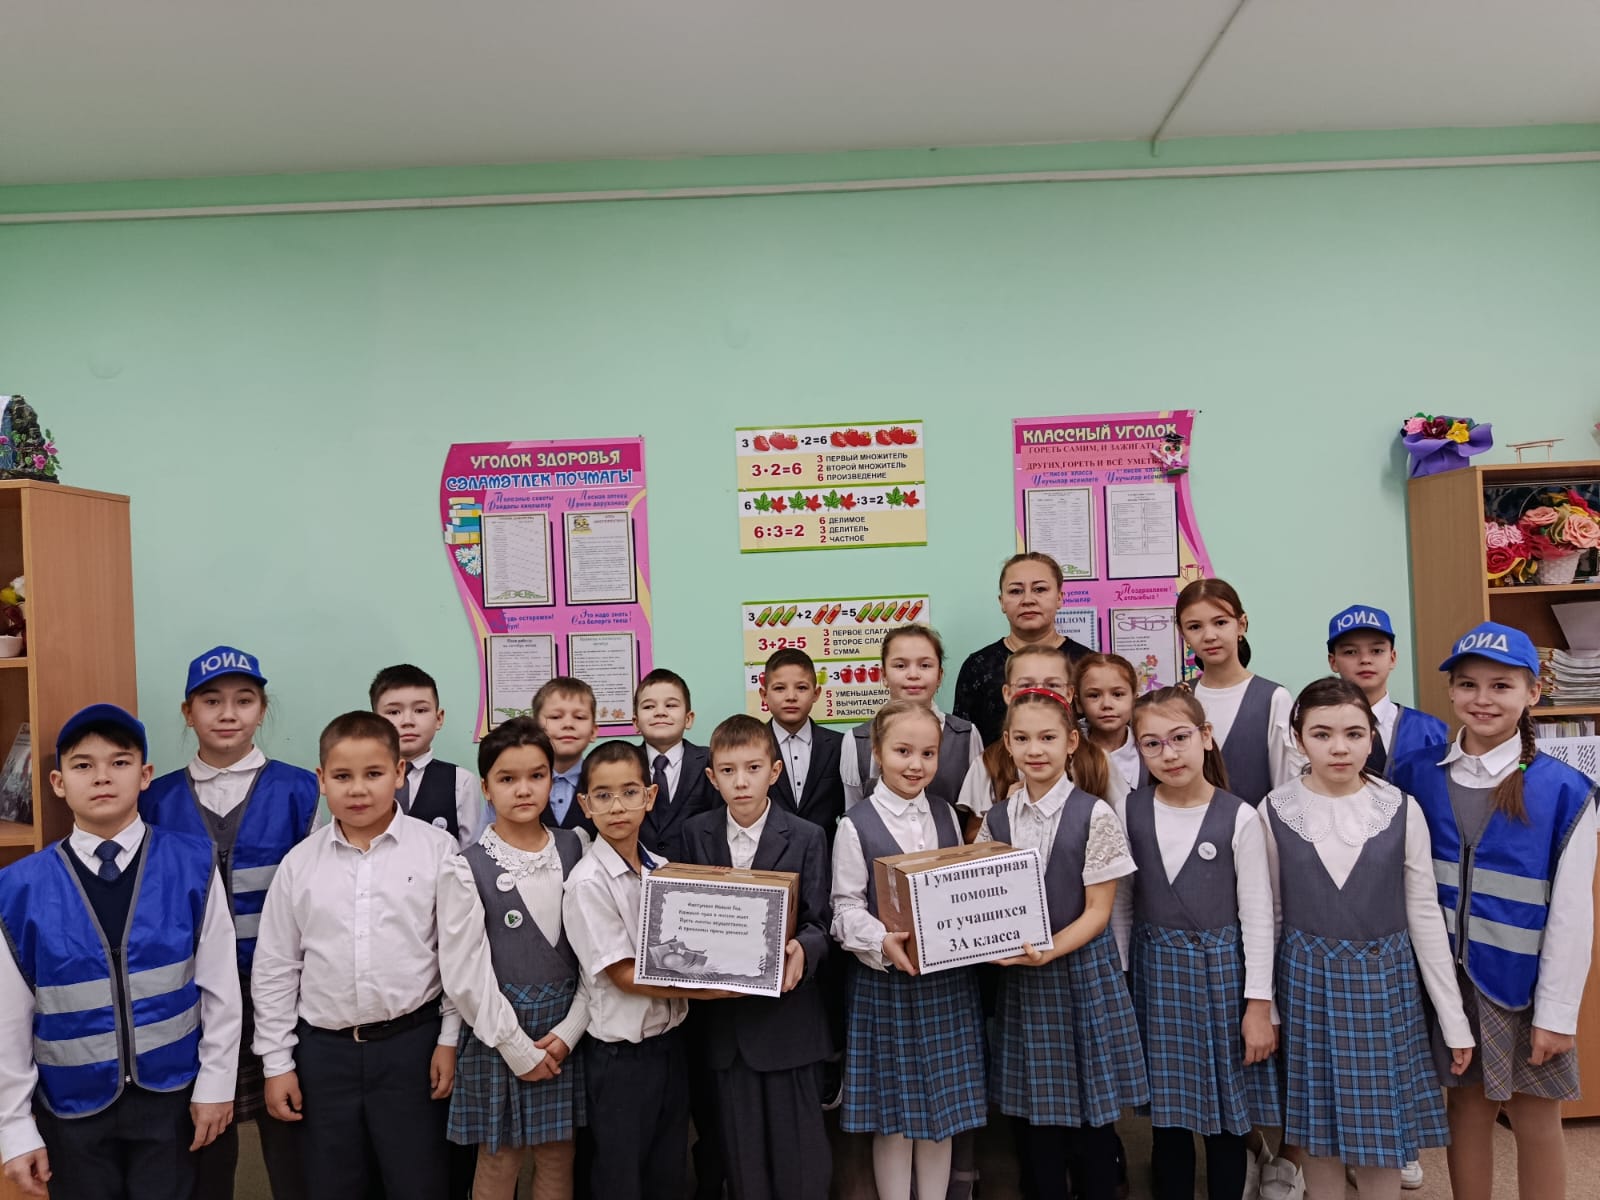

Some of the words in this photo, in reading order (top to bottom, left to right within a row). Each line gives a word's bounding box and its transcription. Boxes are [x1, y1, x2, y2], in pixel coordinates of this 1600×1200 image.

[1022, 425, 1111, 443] КЛАССНЫЙ
[1115, 423, 1177, 440] УГОЛОК
[742, 439, 749, 448] 3
[1029, 445, 1062, 454] ГОРЕТЬ
[1063, 444, 1100, 453] САМИМ,
[1101, 443, 1108, 451] И
[470, 453, 532, 470] УГОЛОК
[537, 450, 620, 467] ЗДОРОВЬЯ
[817, 454, 823, 463] 3
[825, 454, 858, 462] ПЕРВЫЙ
[860, 452, 908, 461] МНОЖИТЕЛЬ
[817, 464, 823, 472] 2
[826, 463, 857, 471] ВТОРОЙ
[858, 461, 907, 470] МНОЖИТЕЛЬ
[1097, 459, 1103, 467] И
[446, 473, 551, 491] СӘЛАМӘТЛЕК
[556, 469, 633, 487] ПОЧМАГЫ
[818, 473, 824, 481] 6
[827, 472, 887, 481] ПРОИЗВЕДЕНИЕ
[495, 491, 531, 503] Полезные
[532, 494, 554, 502] советы
[582, 490, 606, 501] Лесная
[745, 501, 752, 510] 6
[819, 516, 826, 525] 6
[829, 516, 866, 525] ДЕЛИМОЕ
[820, 525, 826, 534] 3
[829, 525, 869, 534] ДЕЛИТЕЛЬ
[820, 535, 827, 543] 2
[830, 534, 865, 543] ЧАСТНОЕ
[748, 612, 756, 622] 3
[1053, 616, 1086, 624] ИПЛОМ
[1337, 610, 1381, 632] ЮИД
[823, 628, 830, 637] 3
[823, 638, 830, 646] 2
[833, 638, 863, 646] ВТОРОЕ
[1457, 633, 1509, 654] ЮИД
[824, 648, 831, 656] 5
[833, 648, 860, 656] СУММА
[200, 652, 252, 676] ЮИД
[751, 675, 758, 684] 5
[825, 690, 832, 698] 5
[835, 689, 890, 698] УМЕНЬШАЕМО
[826, 699, 833, 708] 3
[826, 709, 833, 717] 2
[836, 708, 876, 717] РАЗНОСТЬ
[924, 859, 1029, 888] Гуманитарная
[950, 885, 1008, 904] помощь
[937, 918, 953, 931] от
[956, 905, 1027, 930] учащихся
[950, 938, 969, 953] 3А
[972, 929, 1021, 948] класса
